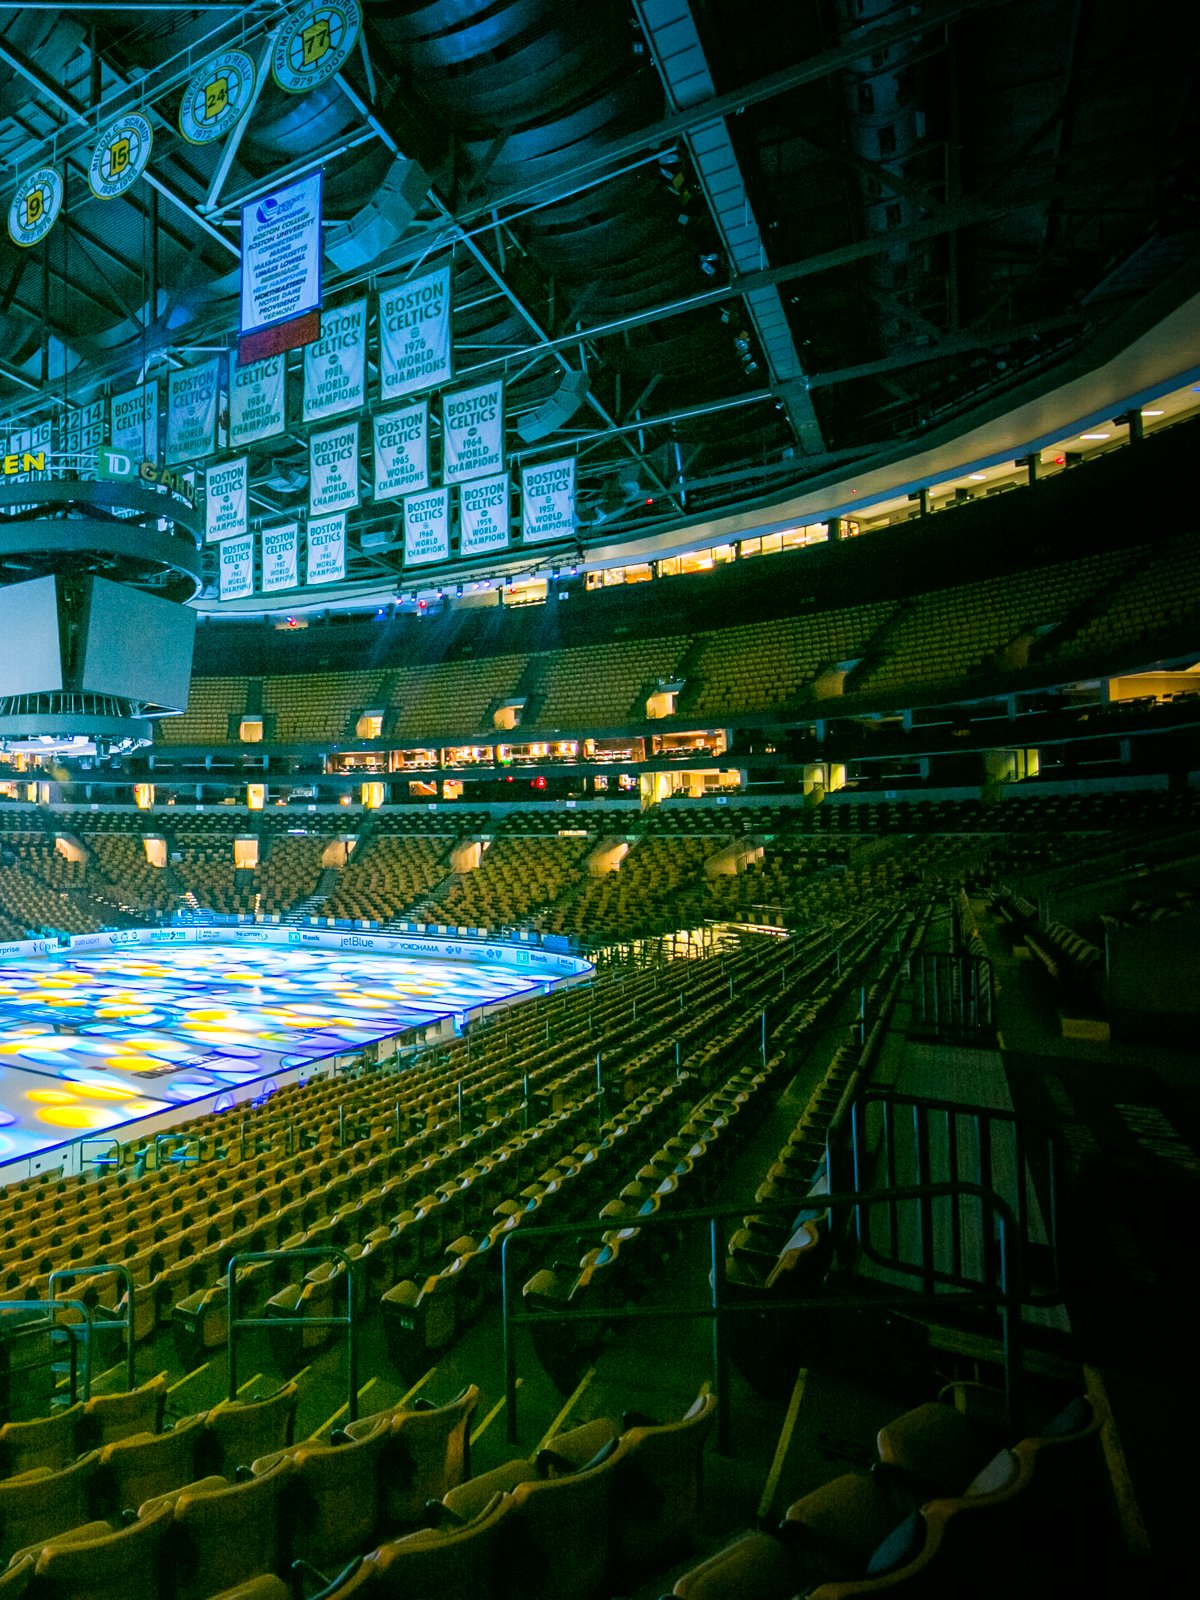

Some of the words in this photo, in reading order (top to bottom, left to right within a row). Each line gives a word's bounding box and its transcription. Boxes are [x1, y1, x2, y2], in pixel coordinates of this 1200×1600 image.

[276, 10, 306, 71] RAYMOND
[304, 29, 328, 55] 77
[207, 88, 227, 110] 24
[92, 131, 112, 172] MILTON
[123, 116, 150, 143] SCHMIDT
[112, 145, 128, 170] 15
[29, 197, 41, 218] 9
[248, 236, 275, 252] BOSTON
[276, 216, 316, 239] UNIVERSITY
[253, 225, 280, 242] BOSTON
[282, 211, 311, 230] COLLEGE
[258, 230, 304, 255] CONNECTICUT
[269, 243, 292, 258] MAINE
[255, 264, 279, 279] UMASS
[254, 276, 307, 302] NORTHEASTERN
[281, 285, 302, 299] DAME
[258, 294, 301, 316] PROVIDENCE
[385, 281, 444, 317] BOSTON
[263, 303, 296, 321] VERMONT
[387, 300, 443, 333] CELTICS
[320, 312, 361, 340] OSTON
[311, 330, 359, 359] CELTICS
[403, 338, 427, 354] 1976
[396, 348, 434, 371] WORLD
[236, 361, 279, 388] CELTICS
[323, 364, 343, 381] 1981
[385, 357, 447, 387] CHAMPIONS
[172, 369, 214, 395] BOSTON
[316, 376, 350, 395] WORLD
[115, 391, 154, 417] BOSTON
[173, 386, 212, 409] CELTICS
[305, 385, 361, 411] CHAMPIONS
[448, 391, 498, 417] BOSTON
[85, 404, 100, 423] 14
[116, 407, 152, 432] CELTICS
[241, 404, 272, 422] WORLD
[450, 406, 496, 431] CELTICS
[35, 424, 49, 443] 16
[232, 412, 281, 436] CHAMPIONS
[378, 412, 423, 437] BOSTON
[15, 435, 23, 450] 1
[85, 425, 100, 445] 15
[313, 432, 355, 456] BOSTON
[379, 426, 422, 449] CELTICS
[462, 436, 483, 450] 1964
[315, 448, 354, 467] CELTICS
[392, 454, 410, 467] 1965
[448, 452, 500, 475] CHAMPIONS
[457, 446, 490, 462] WORLD
[103, 453, 131, 475] TD
[386, 463, 415, 479] WORLD
[209, 466, 244, 487] BOSTON
[326, 473, 343, 485] 1966
[378, 471, 425, 491] CHAMPIONS
[526, 466, 571, 487] BOSTON
[210, 478, 243, 497] CELTICS
[320, 481, 348, 495] WORLD
[464, 482, 505, 501] BOSTON
[528, 479, 569, 498] CELTICS
[312, 489, 356, 507] CHAMPIONS
[407, 496, 445, 513] BOSTON
[465, 494, 503, 513] CELTICS
[215, 511, 238, 523] WORLD
[409, 507, 444, 525] CELTICS
[535, 511, 563, 524] WORLD
[539, 503, 556, 514] 1957
[209, 518, 245, 534] CHAMPIONS
[310, 521, 343, 537] BOSTON
[472, 525, 498, 537] WORLD
[476, 517, 493, 528] 1959
[525, 519, 572, 535] CHAMPIONS
[264, 530, 295, 546] BOSTON
[311, 531, 341, 546] CELTICS
[414, 537, 438, 548] WORLD
[464, 531, 506, 548] CHAMPIONS
[222, 541, 251, 556] BOSTON
[266, 541, 294, 555] CELTICS
[407, 544, 446, 558] CHAMPIONS
[223, 551, 250, 565] CELTICS
[315, 559, 337, 569] WORLD
[302, 934, 320, 942] Bank
[340, 936, 374, 948] jetBlue
[400, 943, 439, 952] YOKOHAMA
[530, 954, 548, 963] Bank
